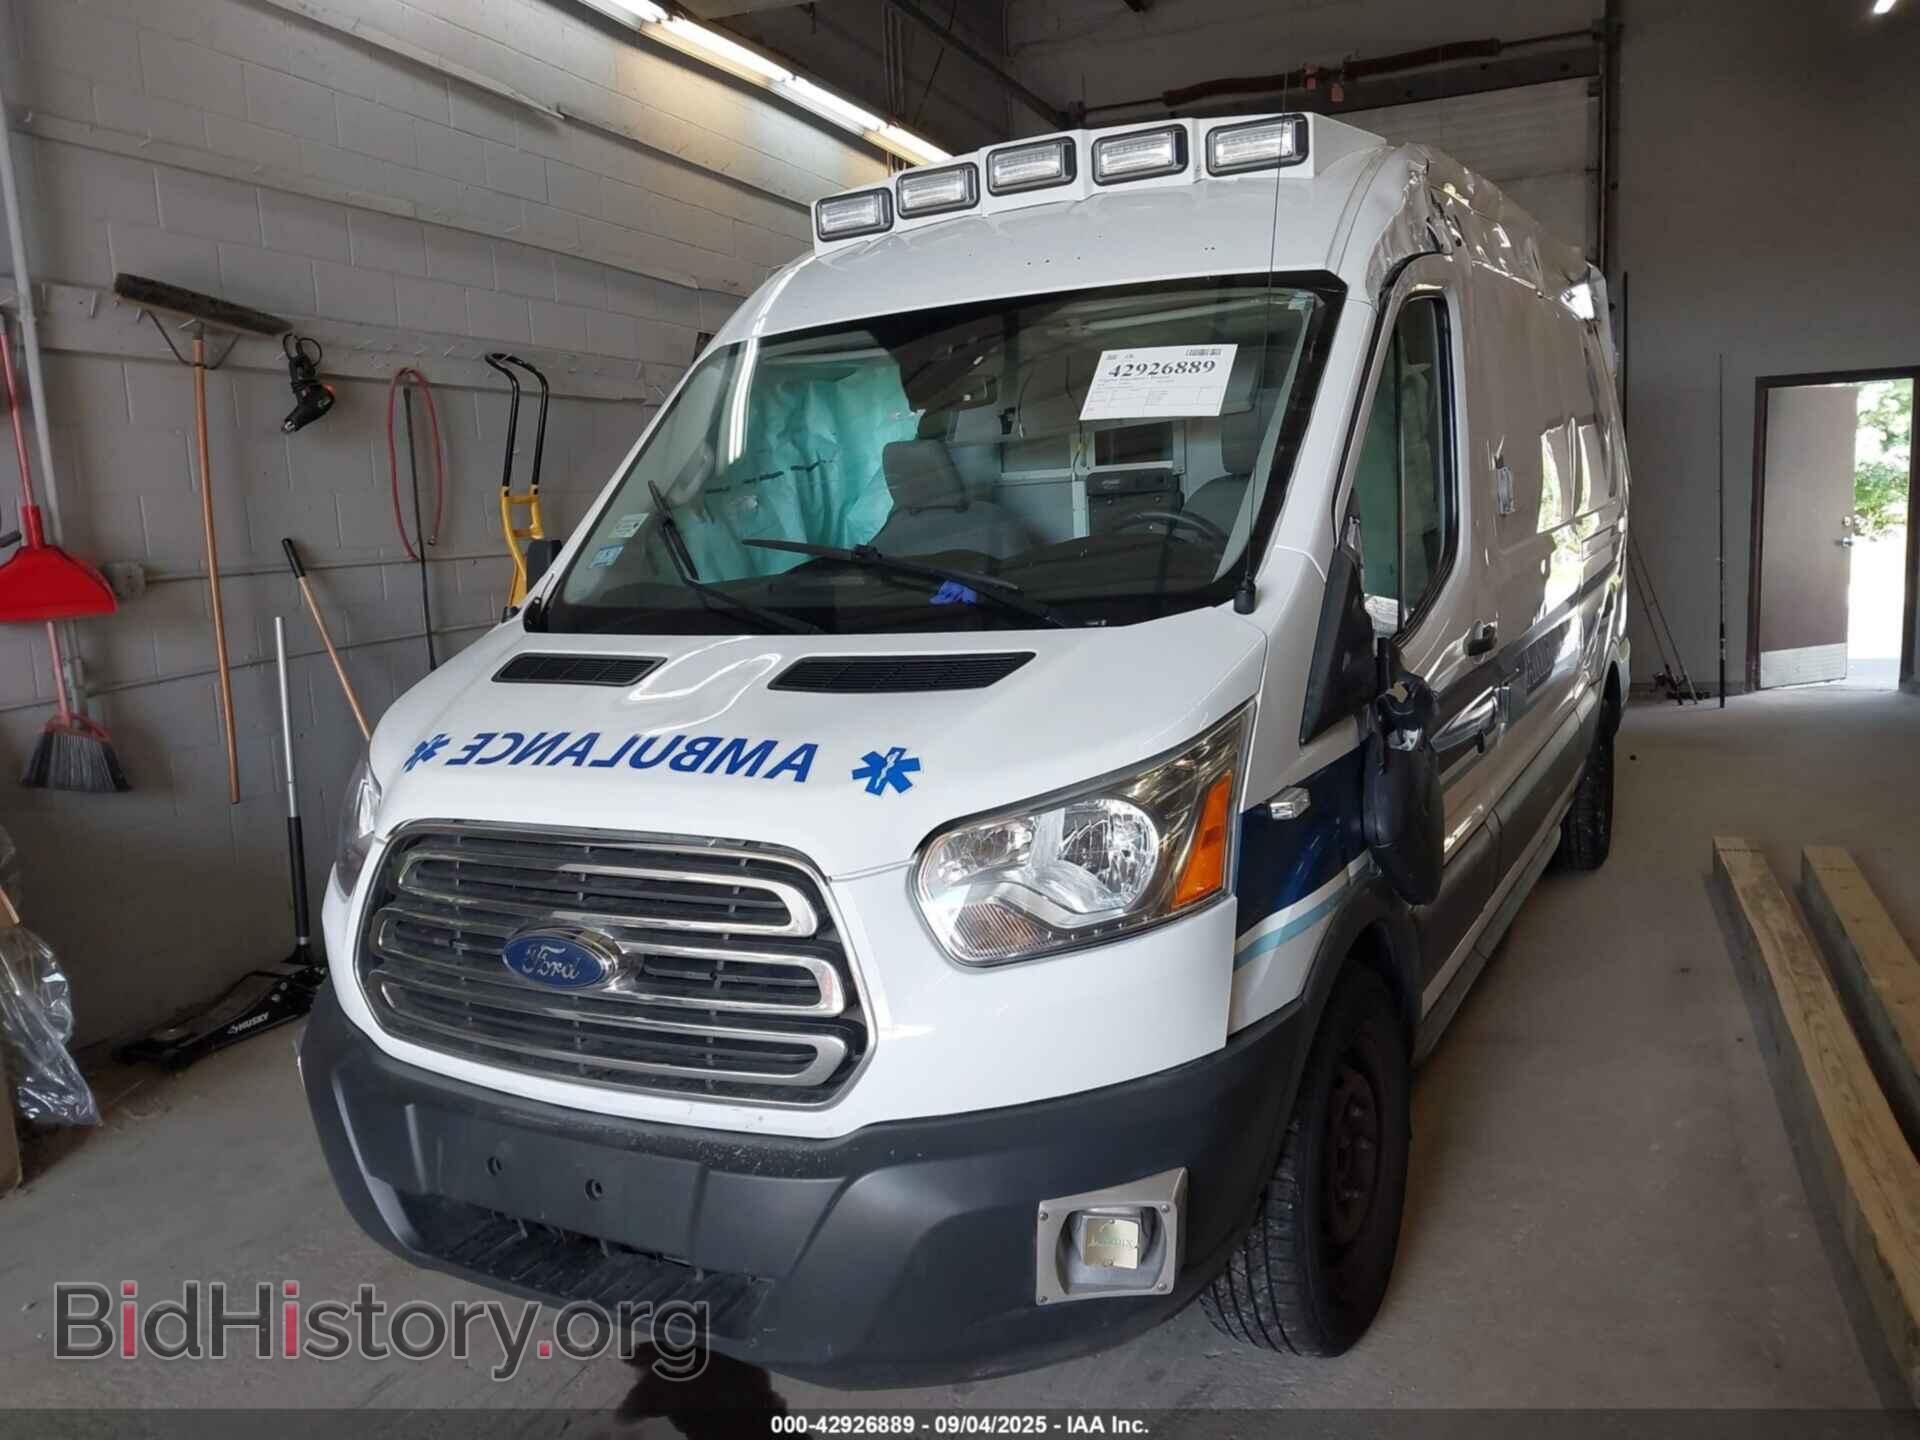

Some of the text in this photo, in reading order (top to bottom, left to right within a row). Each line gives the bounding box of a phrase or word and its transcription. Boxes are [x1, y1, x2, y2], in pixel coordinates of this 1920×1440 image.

[1108, 360, 1216, 377] 42926889
[522, 944, 581, 980] Ford
[238, 1011, 269, 1031] HUSKY
